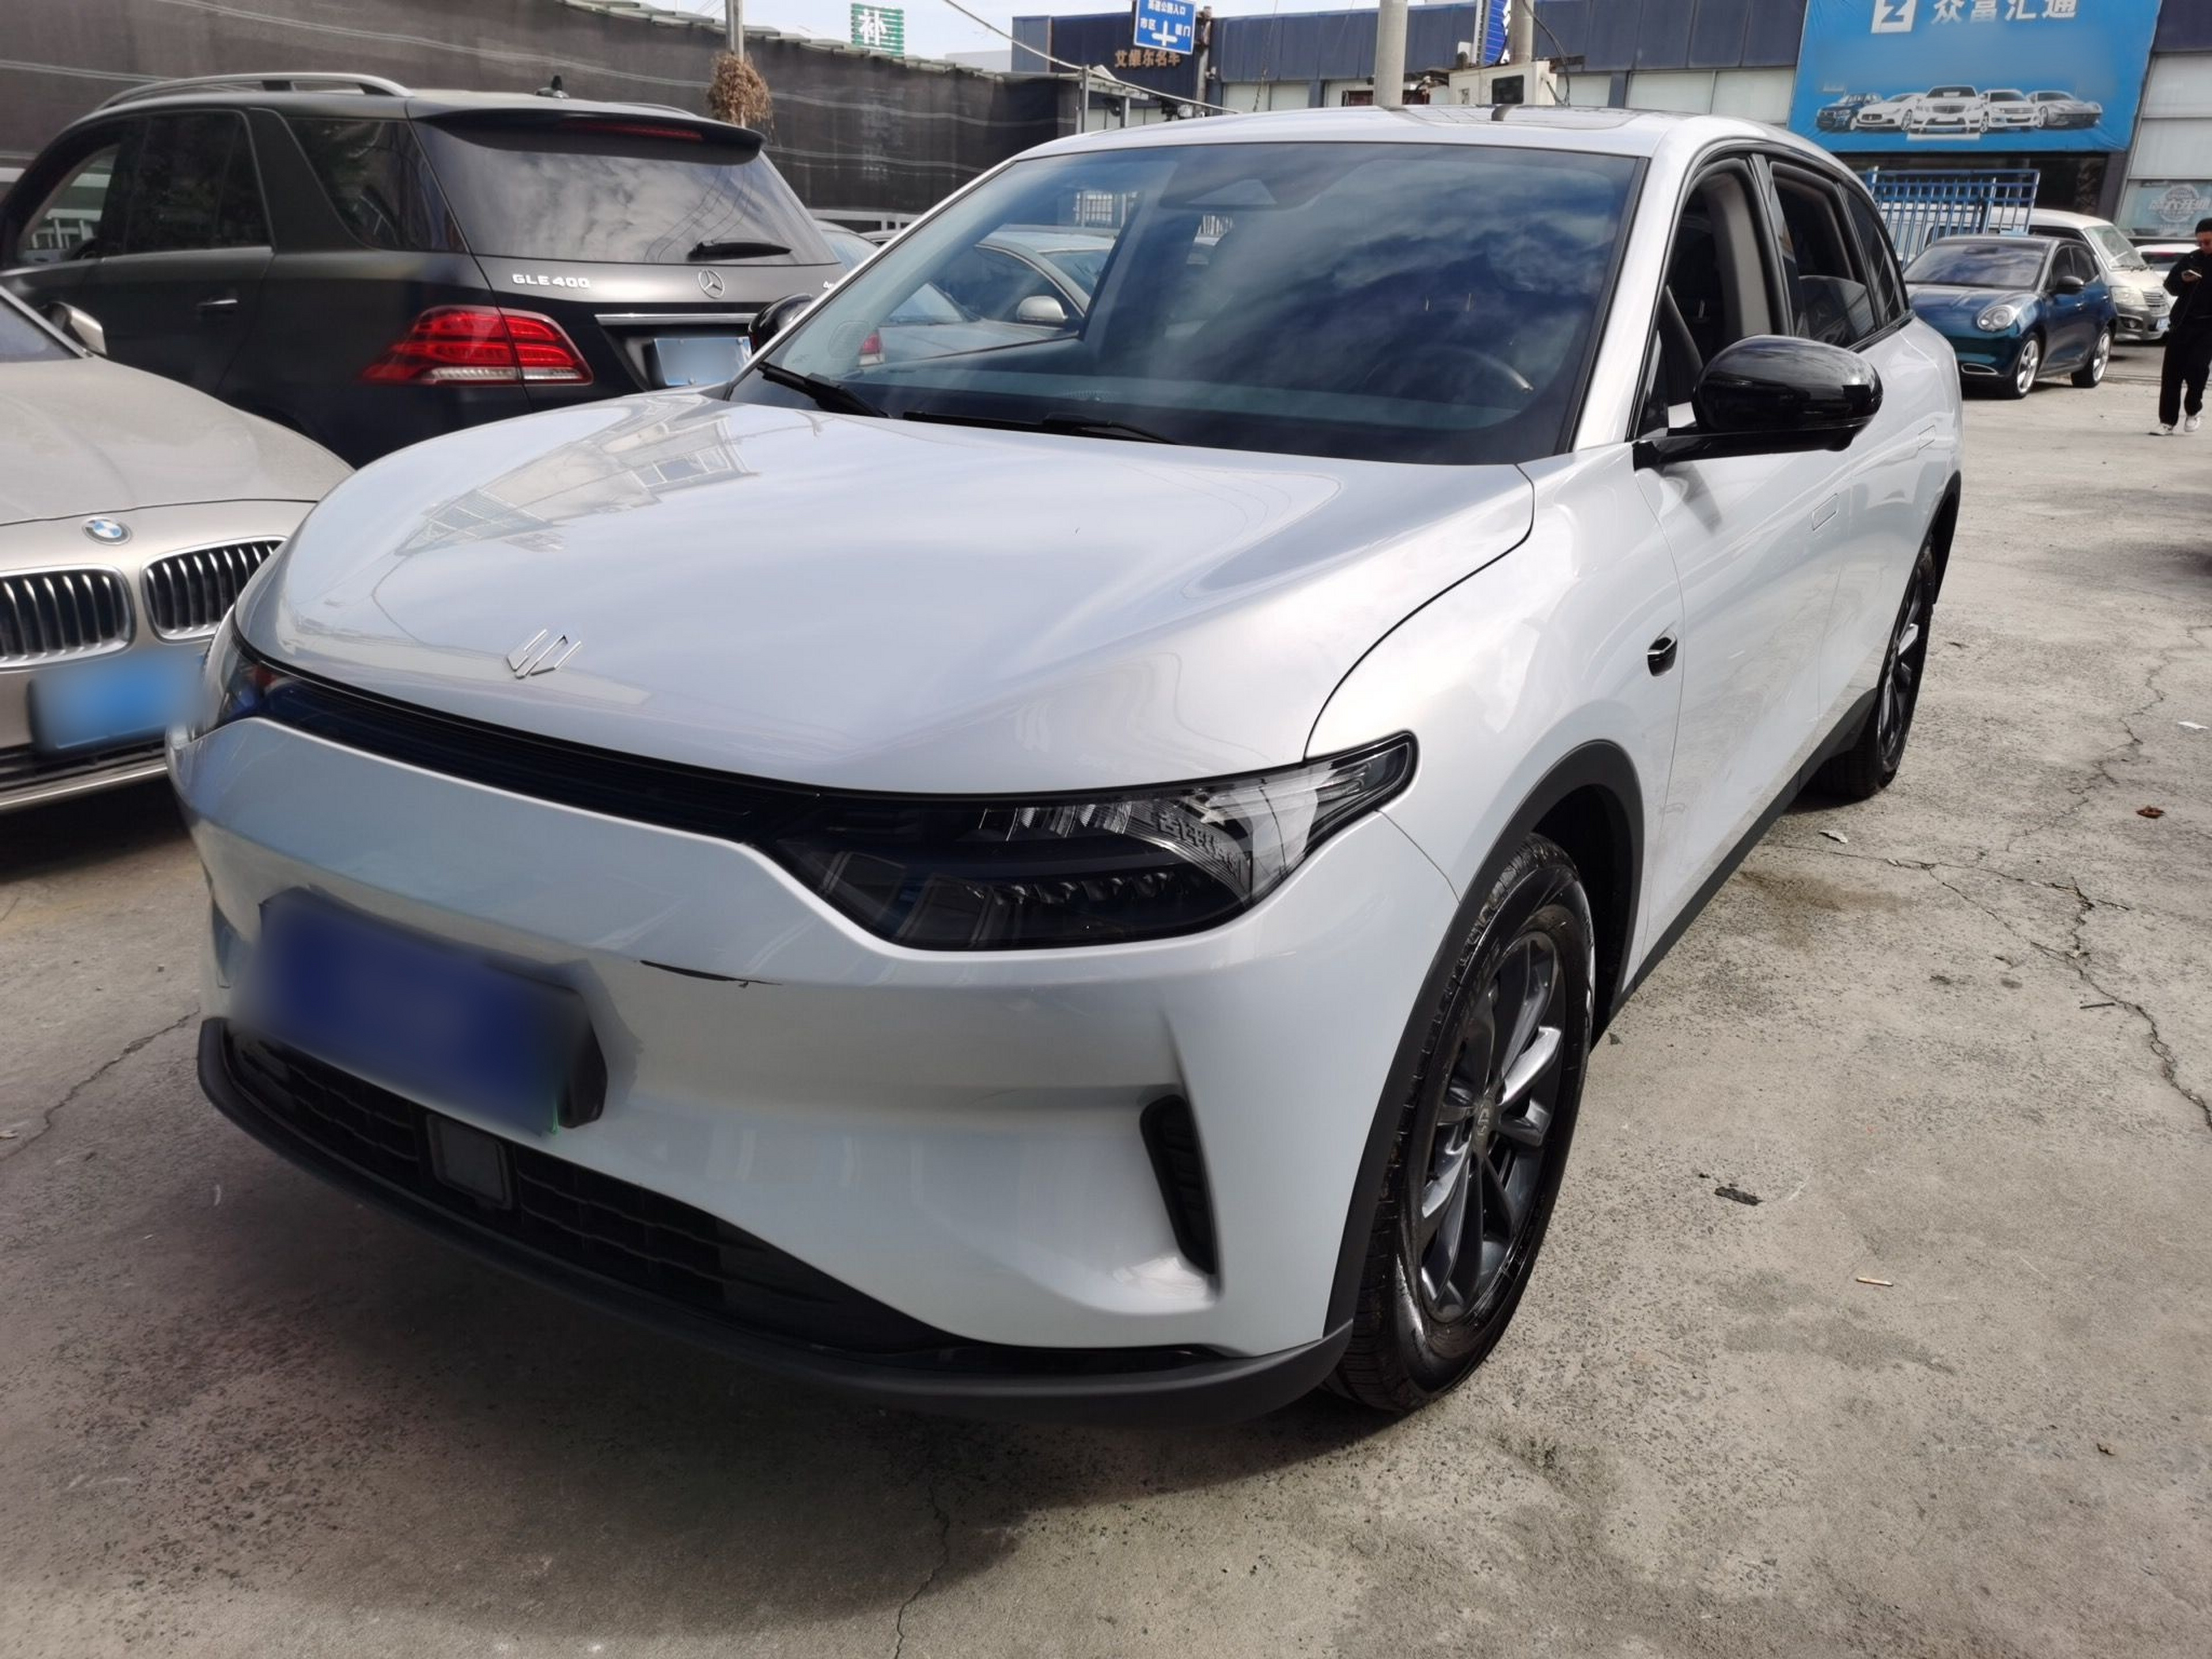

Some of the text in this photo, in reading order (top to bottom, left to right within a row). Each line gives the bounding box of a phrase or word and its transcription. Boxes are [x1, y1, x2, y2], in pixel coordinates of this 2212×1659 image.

[858, 8, 887, 46] 补
[512, 274, 590, 289] GLE 400
